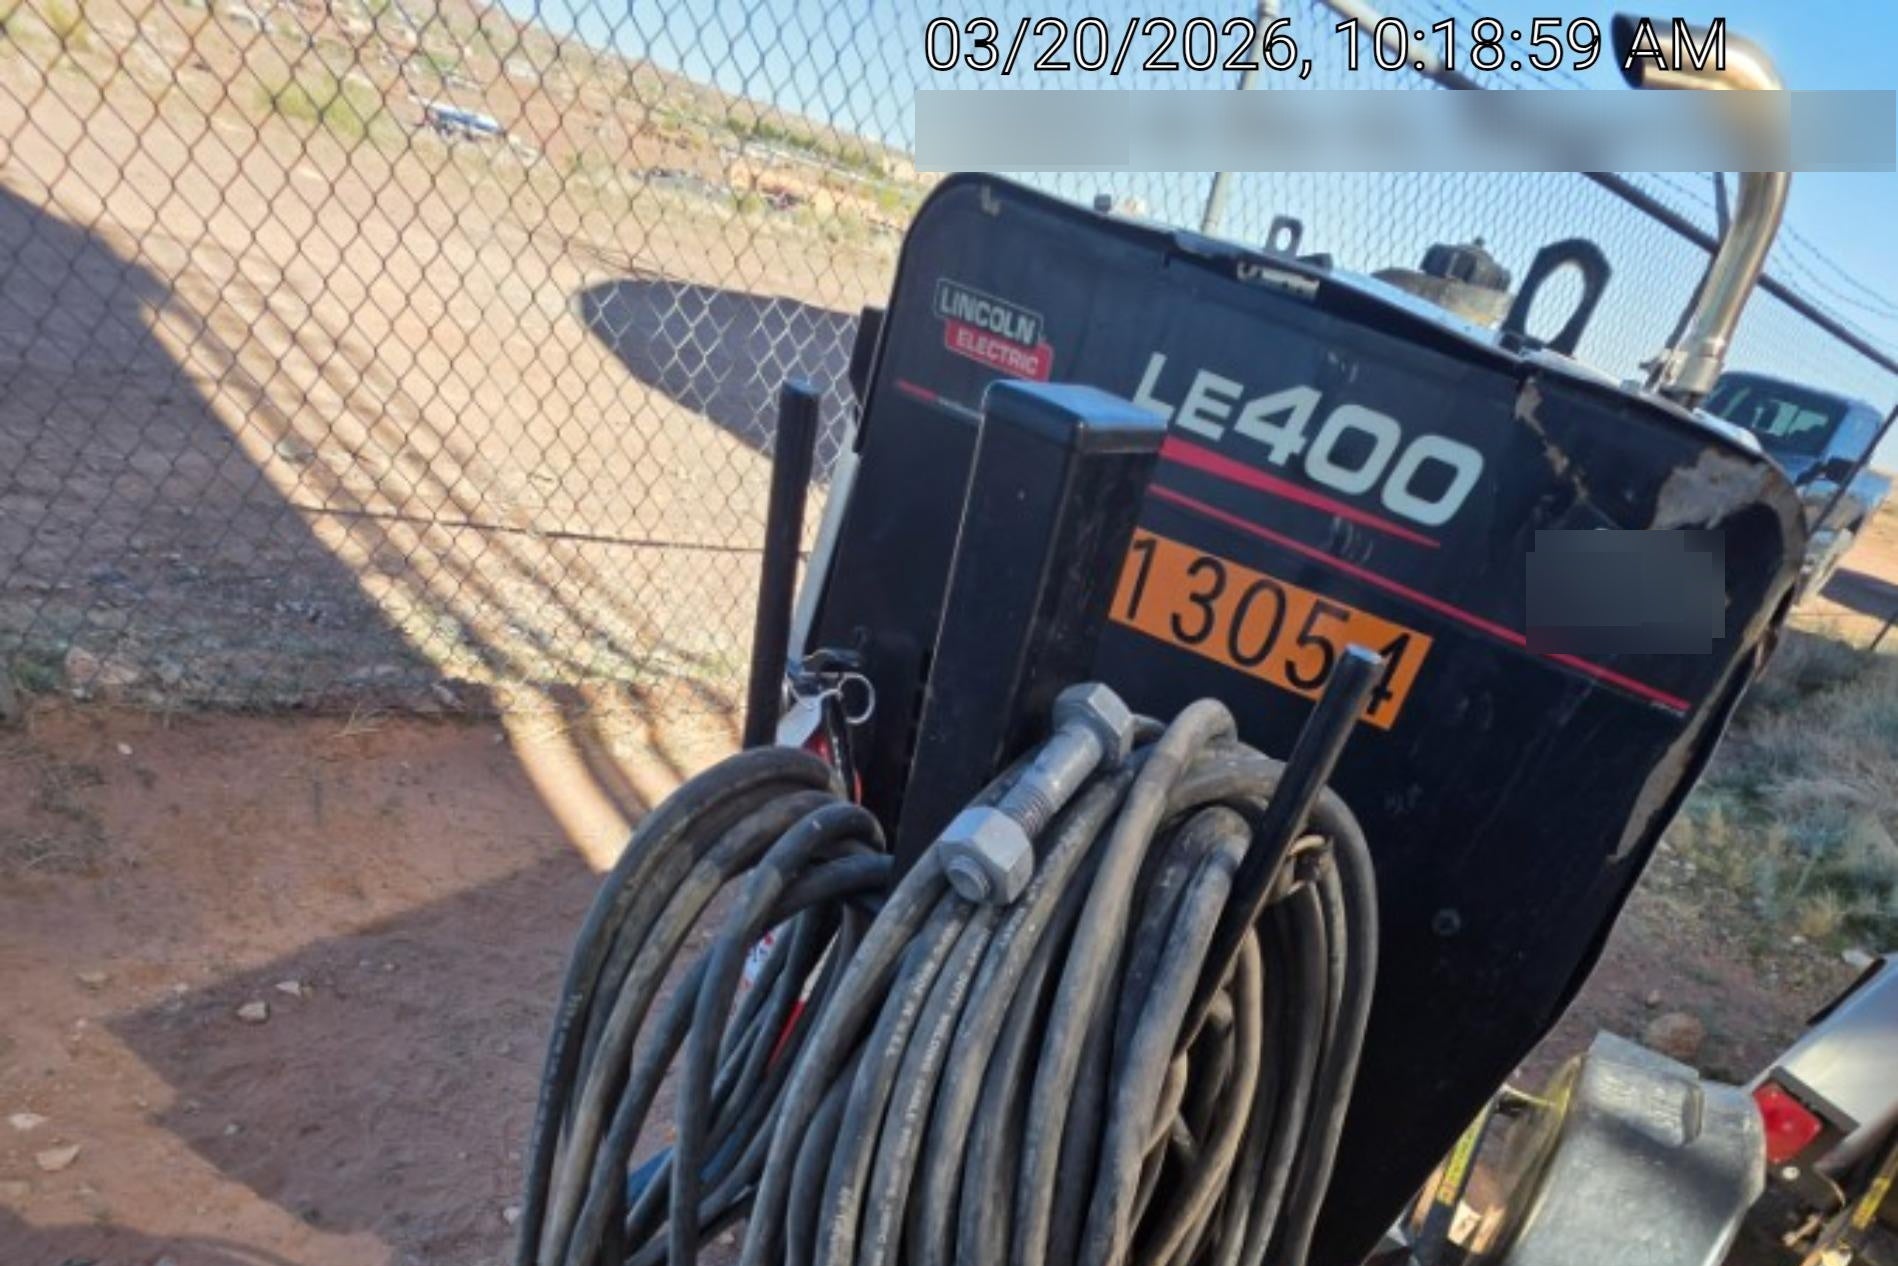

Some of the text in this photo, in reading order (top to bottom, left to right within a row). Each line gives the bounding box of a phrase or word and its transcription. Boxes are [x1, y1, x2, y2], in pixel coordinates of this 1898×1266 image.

[940, 286, 1036, 345] LINCOLN
[956, 327, 1039, 376] ELECTRIC
[1132, 352, 1485, 526] LE400
